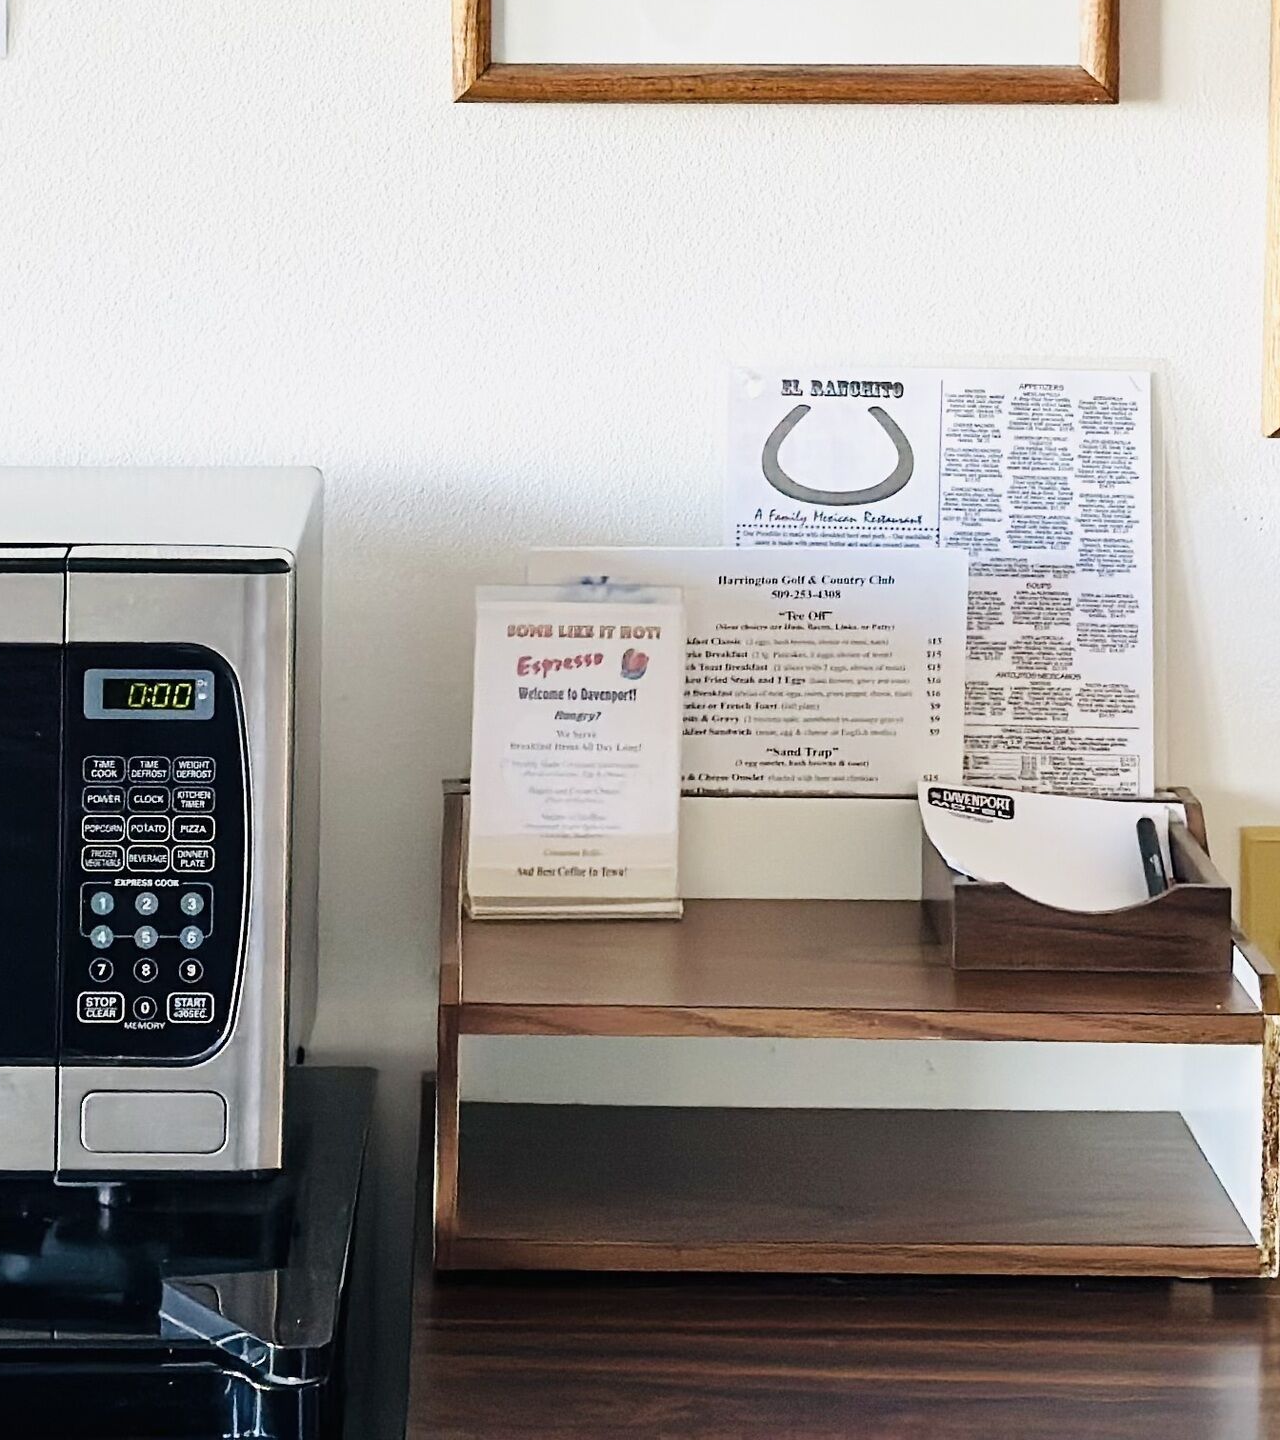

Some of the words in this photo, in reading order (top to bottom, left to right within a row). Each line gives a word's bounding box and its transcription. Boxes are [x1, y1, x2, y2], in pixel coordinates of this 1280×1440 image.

[781, 379, 803, 396] EL
[810, 380, 905, 398] RANCHITO
[754, 508, 763, 521] A
[769, 509, 808, 525] Family
[813, 510, 857, 523] Mexican
[864, 511, 924, 524] Restaurant
[718, 575, 778, 587] Harrington
[781, 575, 806, 585] Golf
[808, 576, 817, 585] &
[821, 575, 866, 587] Country
[869, 575, 895, 585] Club
[771, 590, 841, 600] 509-253-4308
[507, 624, 553, 638] SOME
[558, 625, 594, 639] LIKE
[599, 625, 616, 639] IT
[516, 652, 604, 679] Espresso
[758, 676, 774, 684] and
[128, 683, 192, 708] 0:00
[518, 687, 564, 700] Welcome
[567, 688, 578, 701] to
[580, 688, 637, 704] Davenport!
[720, 702, 751, 710] French
[554, 711, 602, 722] Hungry?
[93, 760, 116, 769] TIME
[140, 760, 159, 769] TIME
[178, 761, 210, 769] WEIGHT
[91, 769, 117, 778] COOK
[131, 770, 167, 778] DEFROST
[176, 770, 212, 778] DEFROST
[87, 795, 121, 803] POWER
[133, 795, 164, 804] CLOCK
[177, 791, 211, 800] KITCHEN
[942, 790, 1012, 811] DAVENPORT
[181, 800, 206, 808] TIMER
[84, 824, 123, 832] POPCORN
[130, 823, 166, 833] POTATO
[180, 825, 207, 833] PIZZA
[91, 850, 117, 858] FROZEN
[128, 854, 168, 863] BEVERAGE
[177, 850, 209, 859] DINNER
[180, 859, 206, 868] PLATE
[114, 879, 152, 887] EXPRESS
[154, 879, 180, 887] COOK
[99, 898, 107, 910] 1
[142, 898, 152, 910] 2
[187, 898, 196, 910] 3
[97, 931, 106, 943] 4
[141, 931, 151, 943] 5
[187, 931, 196, 943] 6
[97, 964, 107, 976] 7
[141, 964, 151, 976] 8
[186, 964, 196, 976] 9
[86, 997, 117, 1008] STOP
[174, 997, 207, 1007] START
[140, 1002, 150, 1014] 0
[86, 1010, 116, 1018] CLEAR
[124, 1022, 166, 1030] MEMORY
